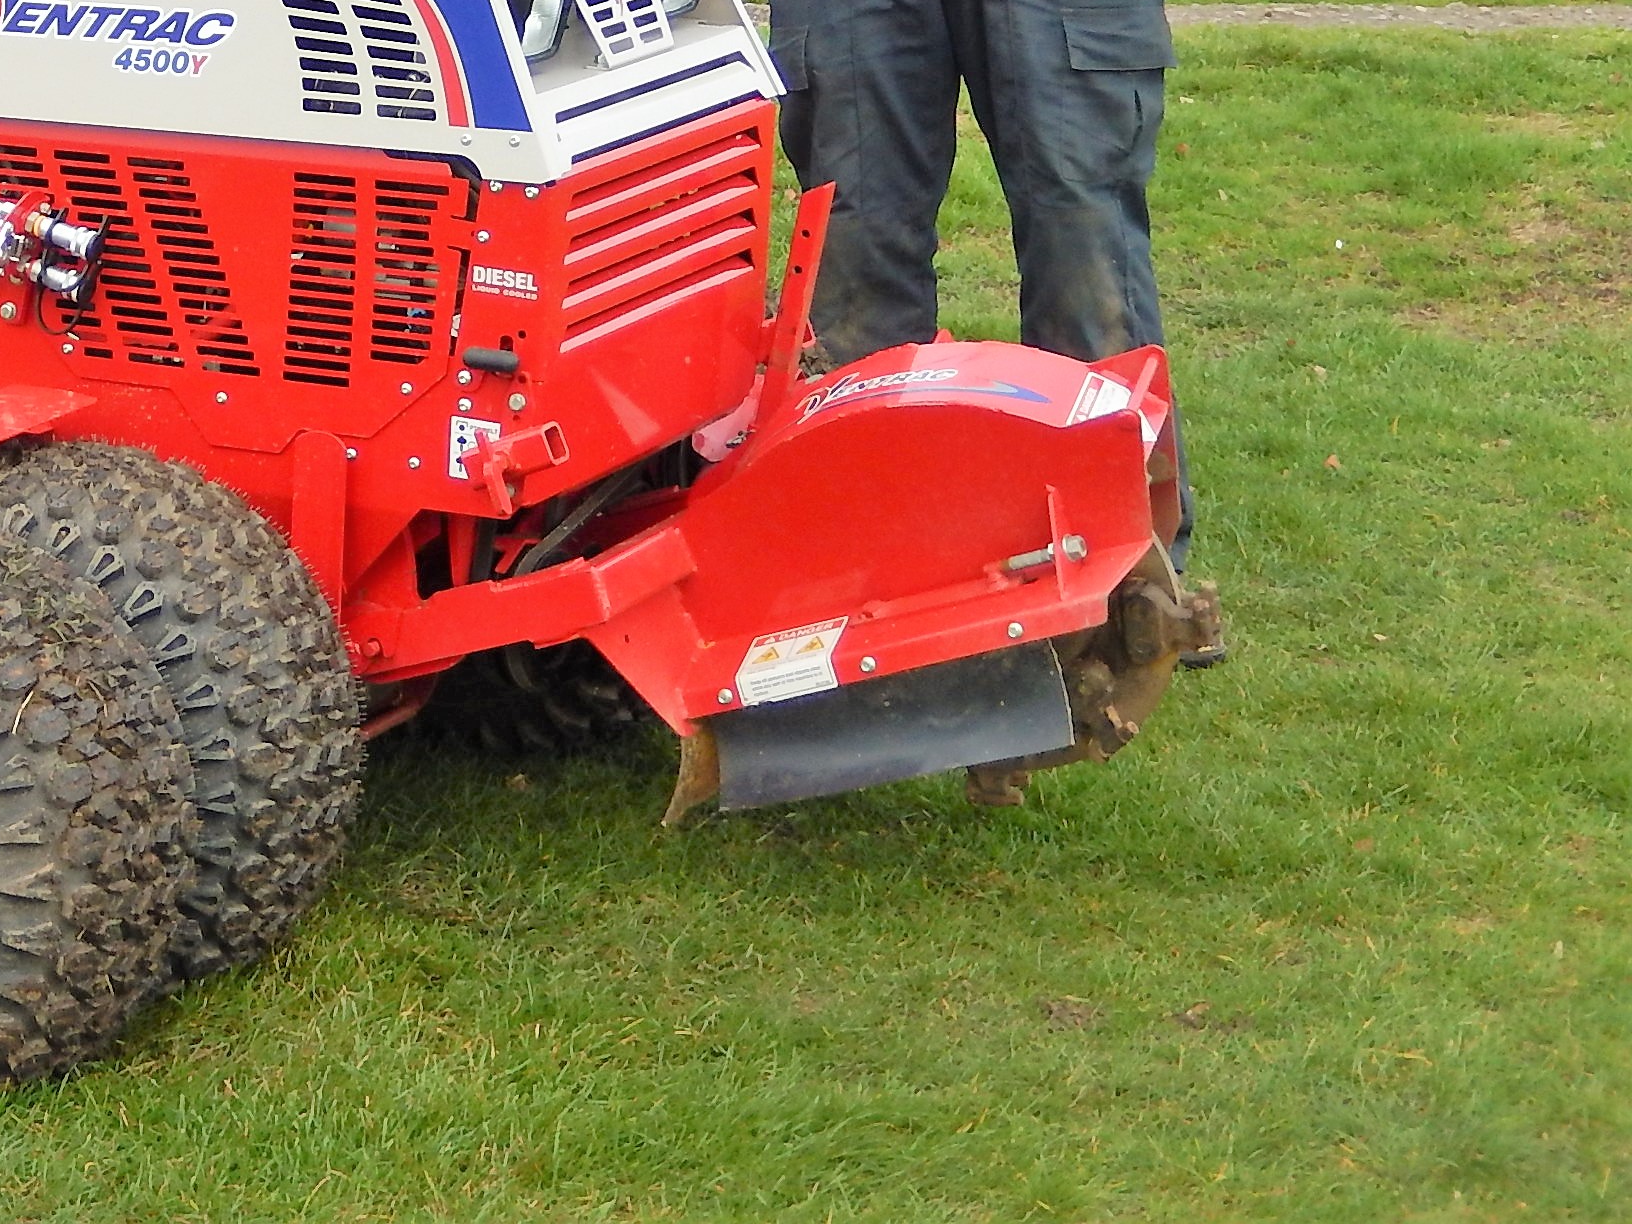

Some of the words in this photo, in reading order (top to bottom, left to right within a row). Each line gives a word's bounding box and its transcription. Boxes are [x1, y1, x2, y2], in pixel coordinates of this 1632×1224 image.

[114, 47, 207, 75] 4500Y
[472, 265, 538, 292] DIESEL
[779, 622, 834, 641] DANGER
